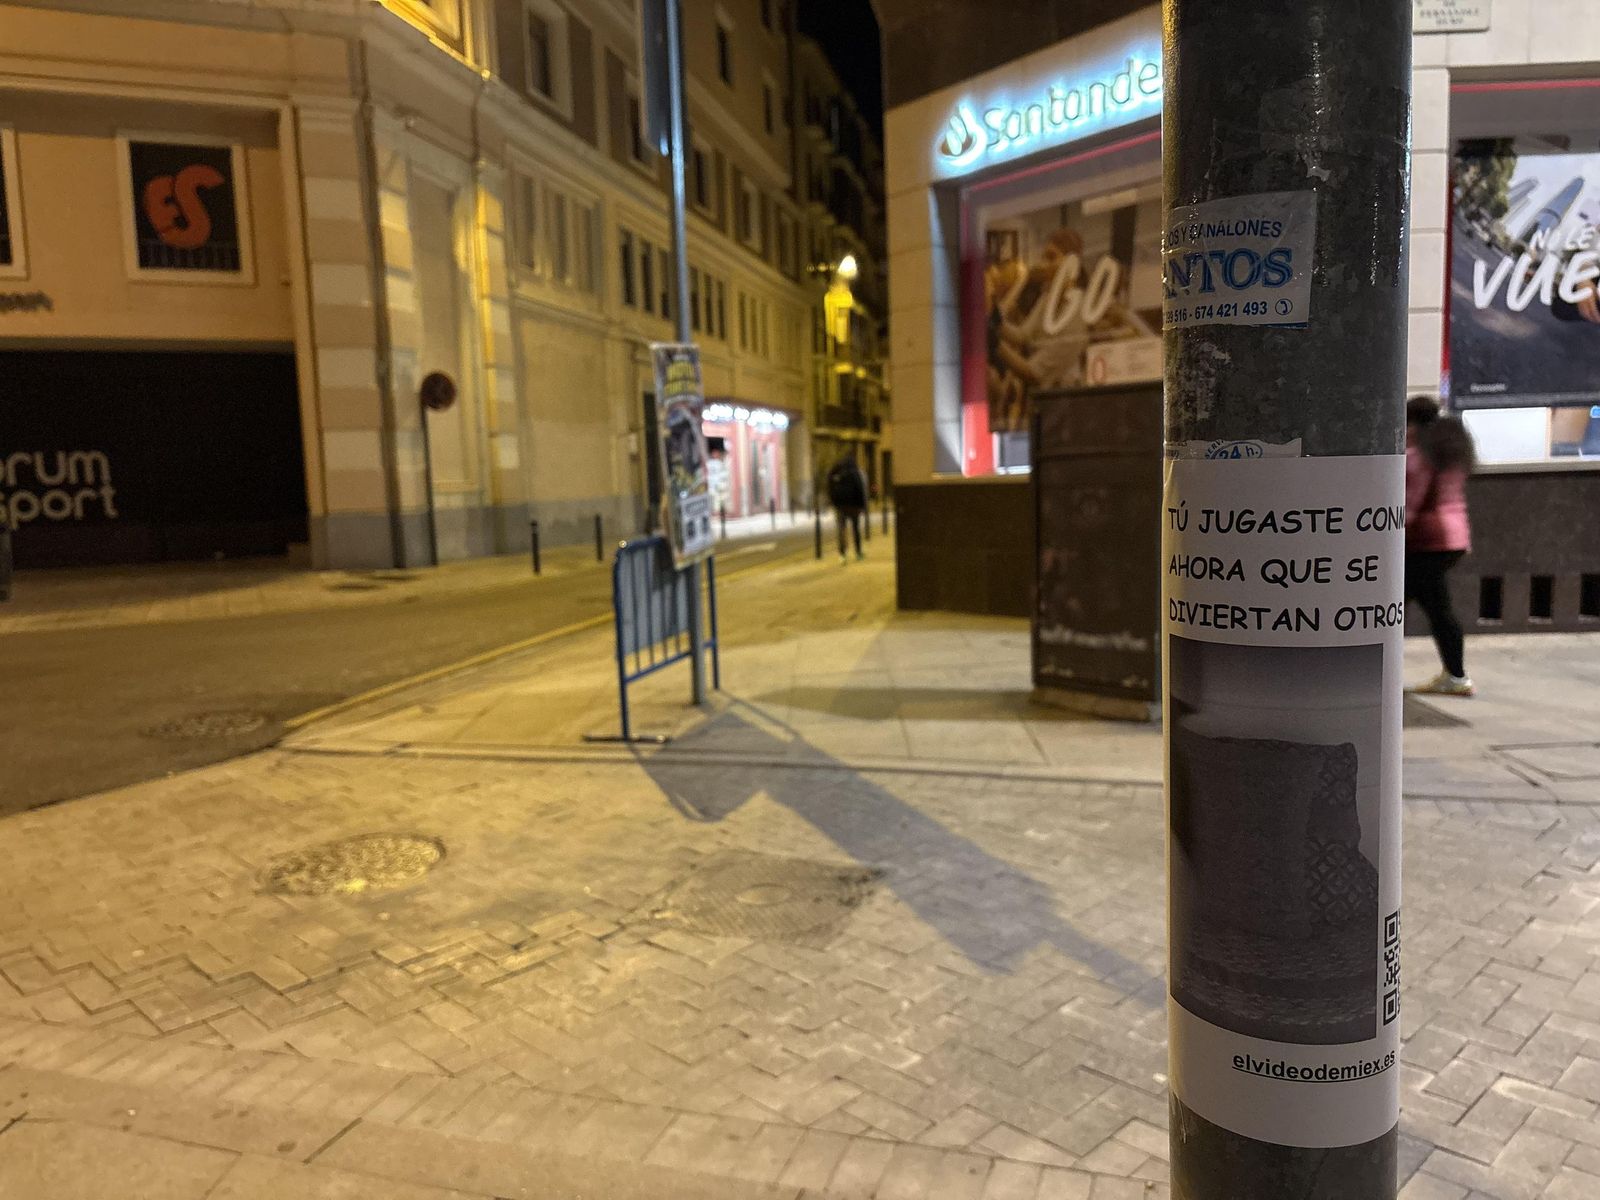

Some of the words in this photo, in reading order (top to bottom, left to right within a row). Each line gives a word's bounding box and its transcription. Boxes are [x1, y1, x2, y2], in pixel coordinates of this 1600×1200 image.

[984, 58, 1162, 148] Santande
[1167, 229, 1180, 248] OS
[1180, 226, 1188, 243] Y
[1164, 248, 1292, 298] NTOS
[1473, 252, 1600, 312] VUE
[1174, 308, 1187, 322] 516
[1194, 303, 1213, 320] 674
[1216, 303, 1238, 318] 421
[1242, 301, 1268, 315] 493
[0, 450, 111, 487] rum
[1168, 500, 1189, 532] TÚ
[1198, 507, 1344, 534] JUGASTE
[1356, 506, 1405, 532] CONM
[1169, 554, 1246, 582] AHORA
[1260, 556, 1333, 589] QUE
[1345, 555, 1380, 582] SE
[1169, 598, 1320, 632] DIVIERTAN
[1334, 602, 1403, 632] OTROS
[1232, 1050, 1395, 1082] elvideodemiex.es
